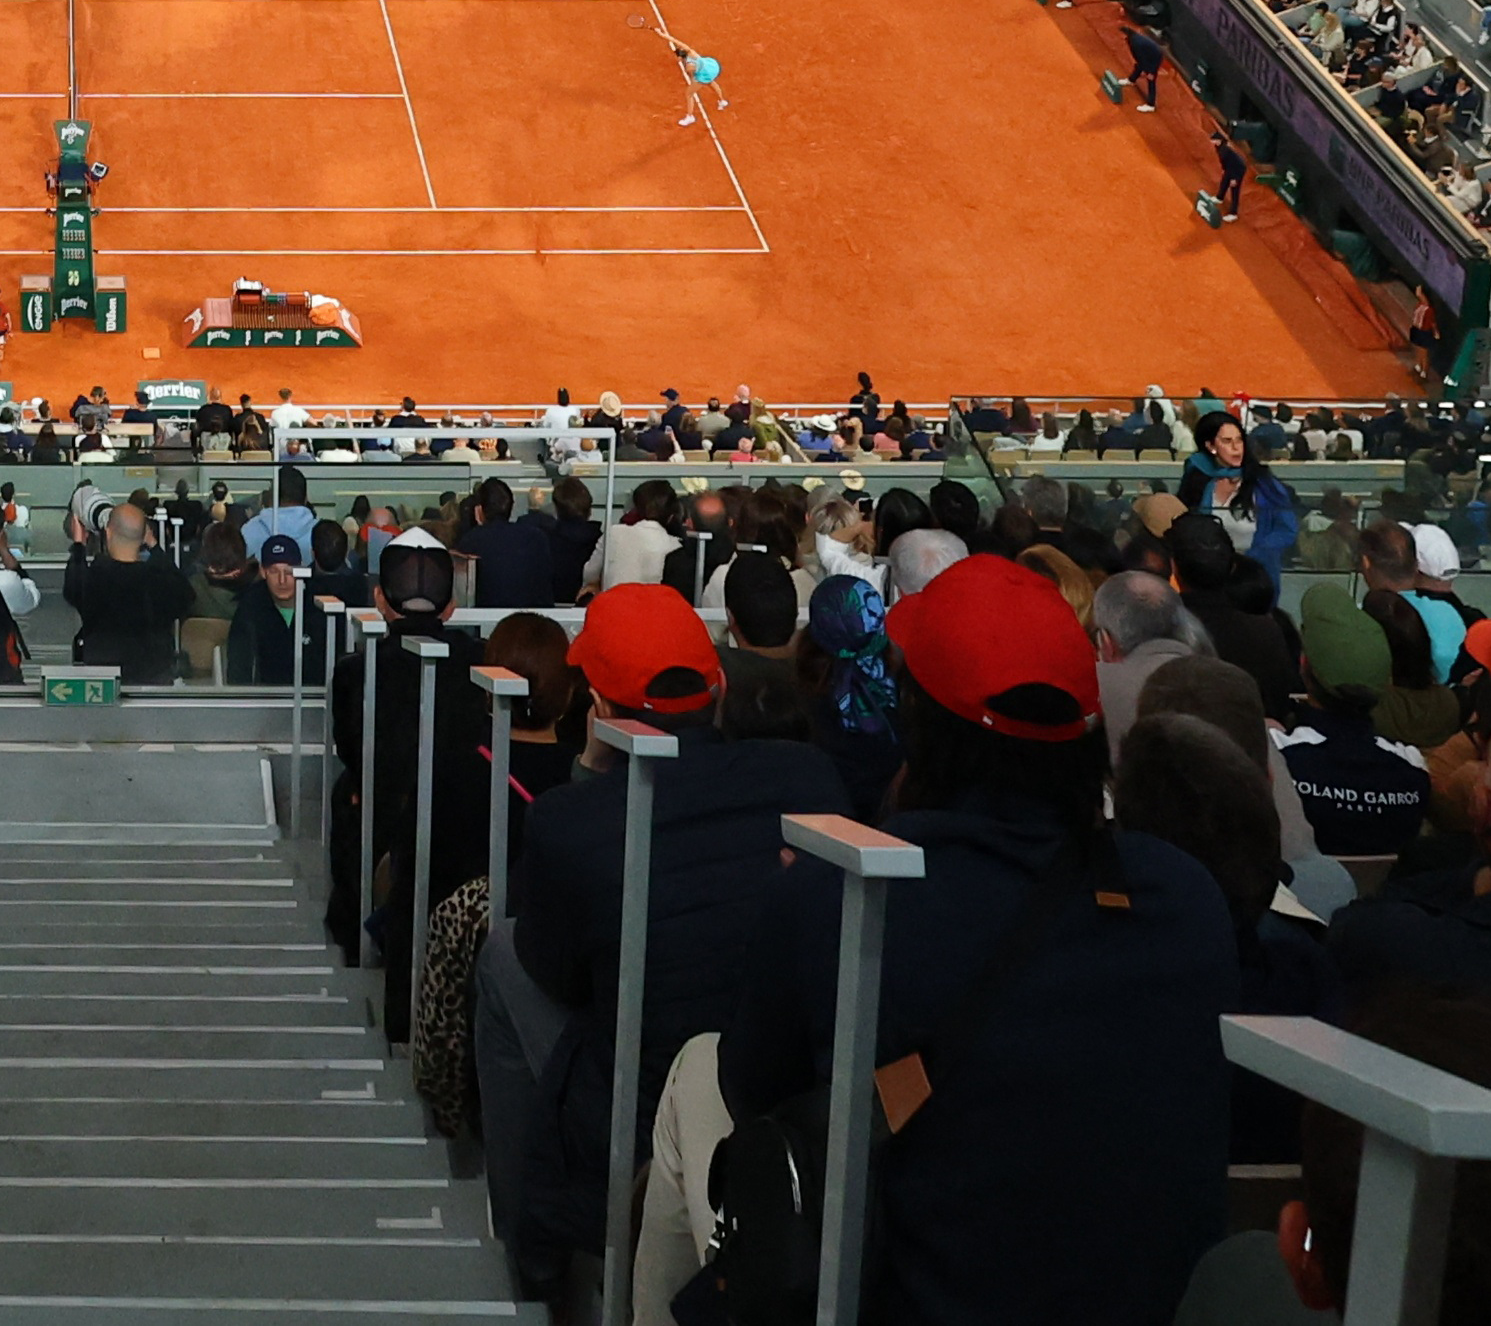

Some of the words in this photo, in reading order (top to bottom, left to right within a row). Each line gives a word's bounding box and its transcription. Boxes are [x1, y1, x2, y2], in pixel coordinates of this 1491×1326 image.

[1217, 8, 1296, 118] PARIBAS
[105, 297, 117, 333] Wilson
[1363, 790, 1420, 806] GARROS
